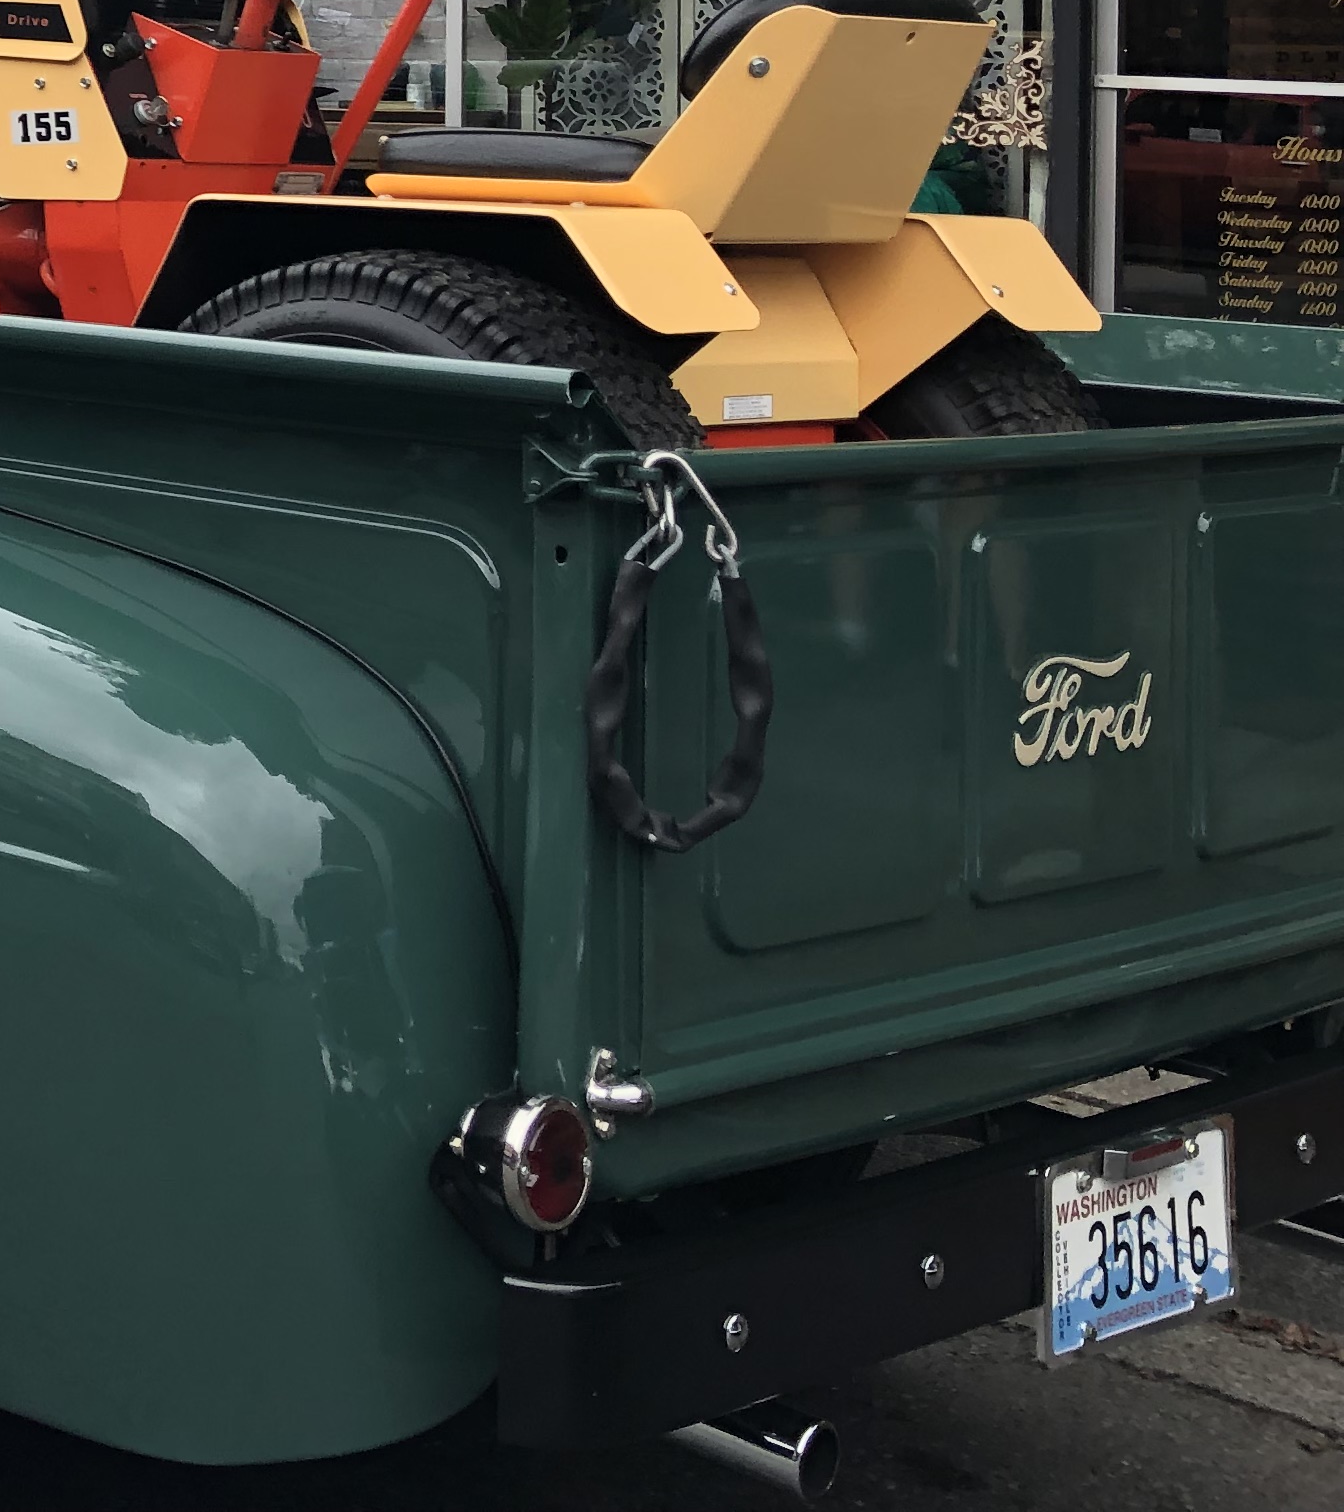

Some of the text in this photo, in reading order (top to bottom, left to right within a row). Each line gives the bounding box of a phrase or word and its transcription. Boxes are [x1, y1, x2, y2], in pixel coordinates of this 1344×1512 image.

[7, 13, 49, 27] Drive
[17, 111, 72, 143] 155
[1272, 136, 1344, 163] Hours
[1219, 186, 1278, 209] Tuesday
[1217, 210, 1293, 234] Wednesday
[1218, 231, 1286, 254] Thursday
[1218, 251, 1268, 273] Friday
[1218, 271, 1284, 294] Saturday
[1218, 291, 1274, 314] Sunday
[1012, 650, 1153, 767] Ford
[1055, 1175, 1159, 1227] WASHINGTON
[1088, 1190, 1209, 1310] 35616
[1054, 1230, 1065, 1340] COLLECTOR
[1062, 1240, 1072, 1327] VEHICLE
[1096, 1288, 1189, 1332] EVERGREEN STATE
